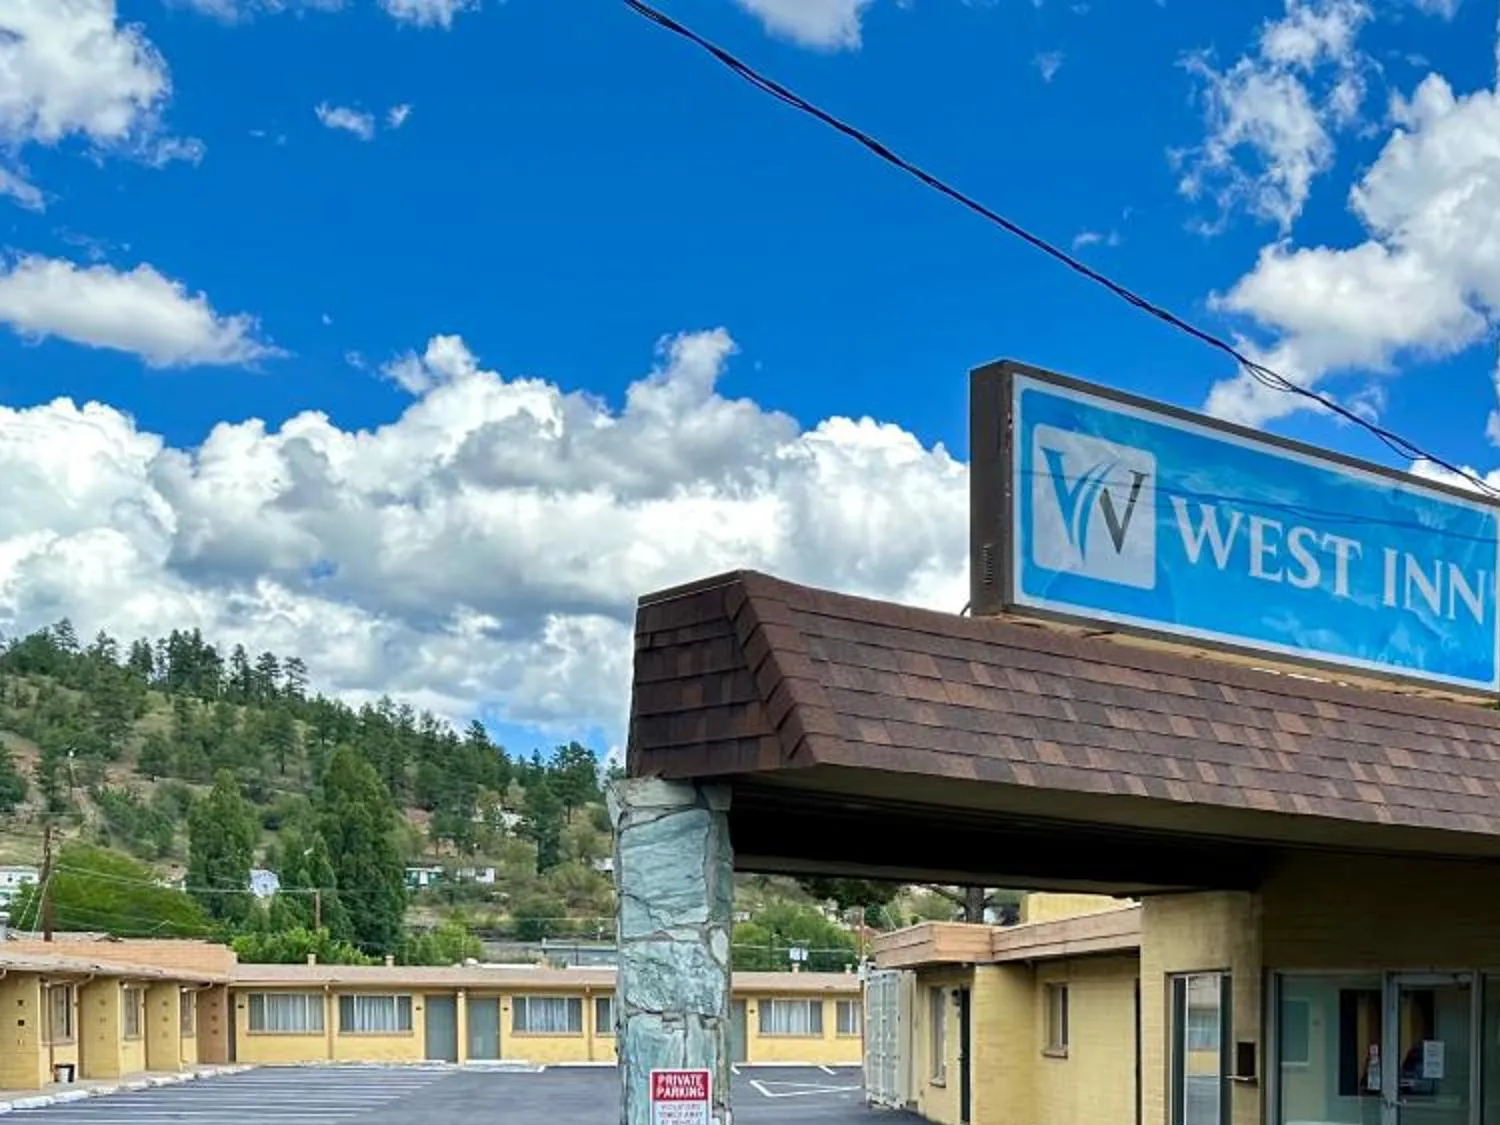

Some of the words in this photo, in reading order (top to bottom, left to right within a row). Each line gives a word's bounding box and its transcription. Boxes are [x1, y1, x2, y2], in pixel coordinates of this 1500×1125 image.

[1168, 496, 1362, 598] WEST
[1383, 547, 1485, 625] INN
[657, 1074, 703, 1086] PRIVATE
[656, 1087, 705, 1099] PARKING
